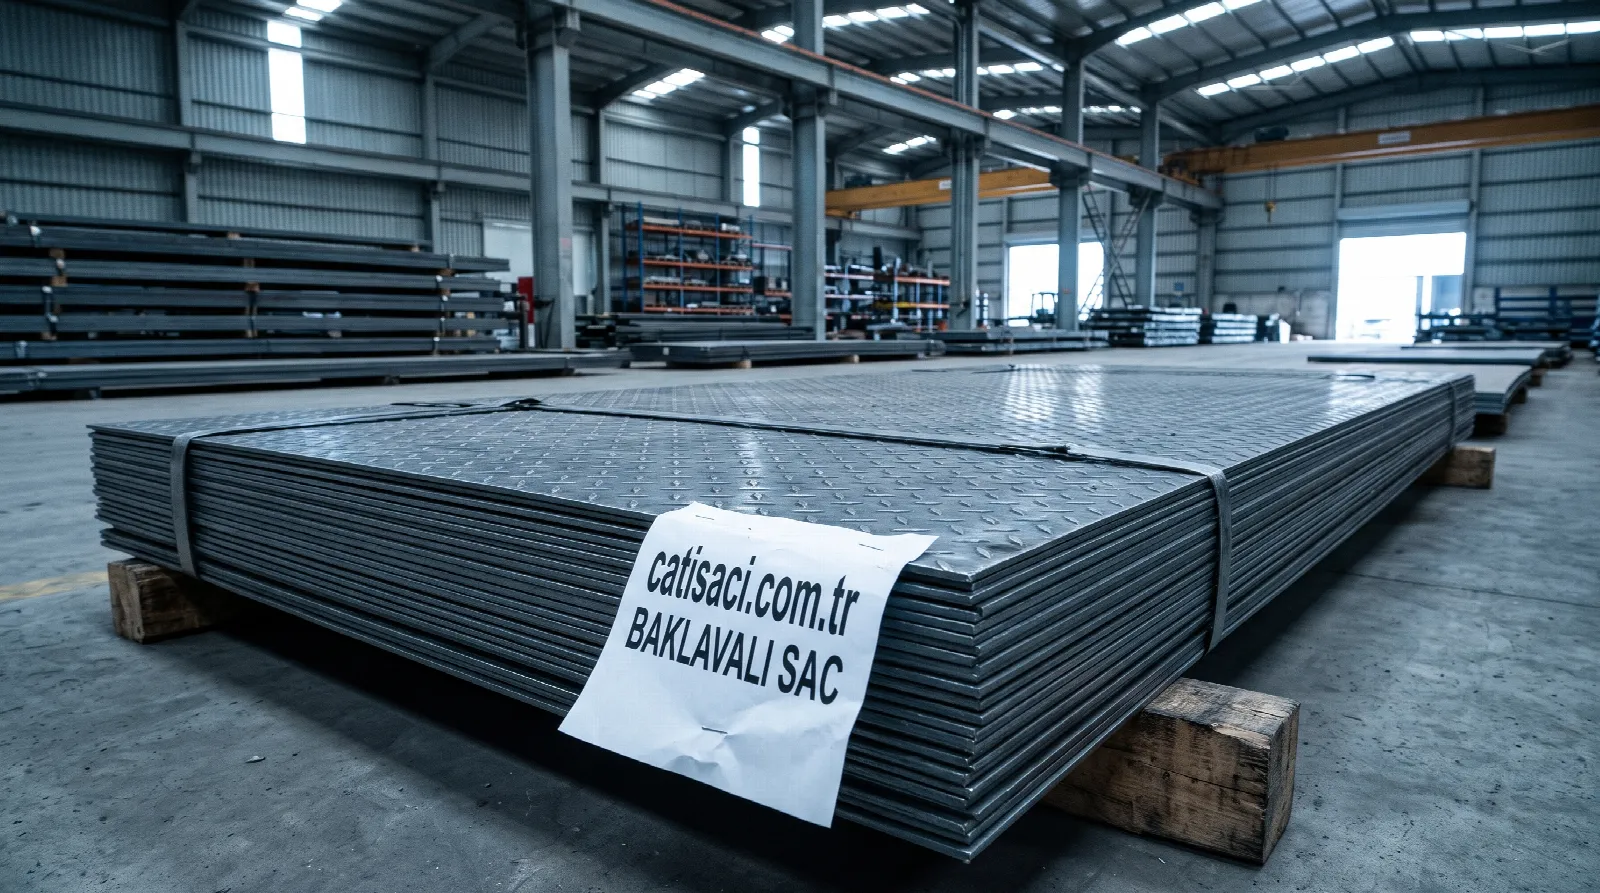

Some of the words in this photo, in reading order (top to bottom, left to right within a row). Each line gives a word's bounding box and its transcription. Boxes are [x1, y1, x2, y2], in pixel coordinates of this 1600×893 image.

[647, 546, 860, 636] catisaci.com.tr
[625, 607, 774, 687] BAKLAVALI
[778, 644, 843, 704] SAC
